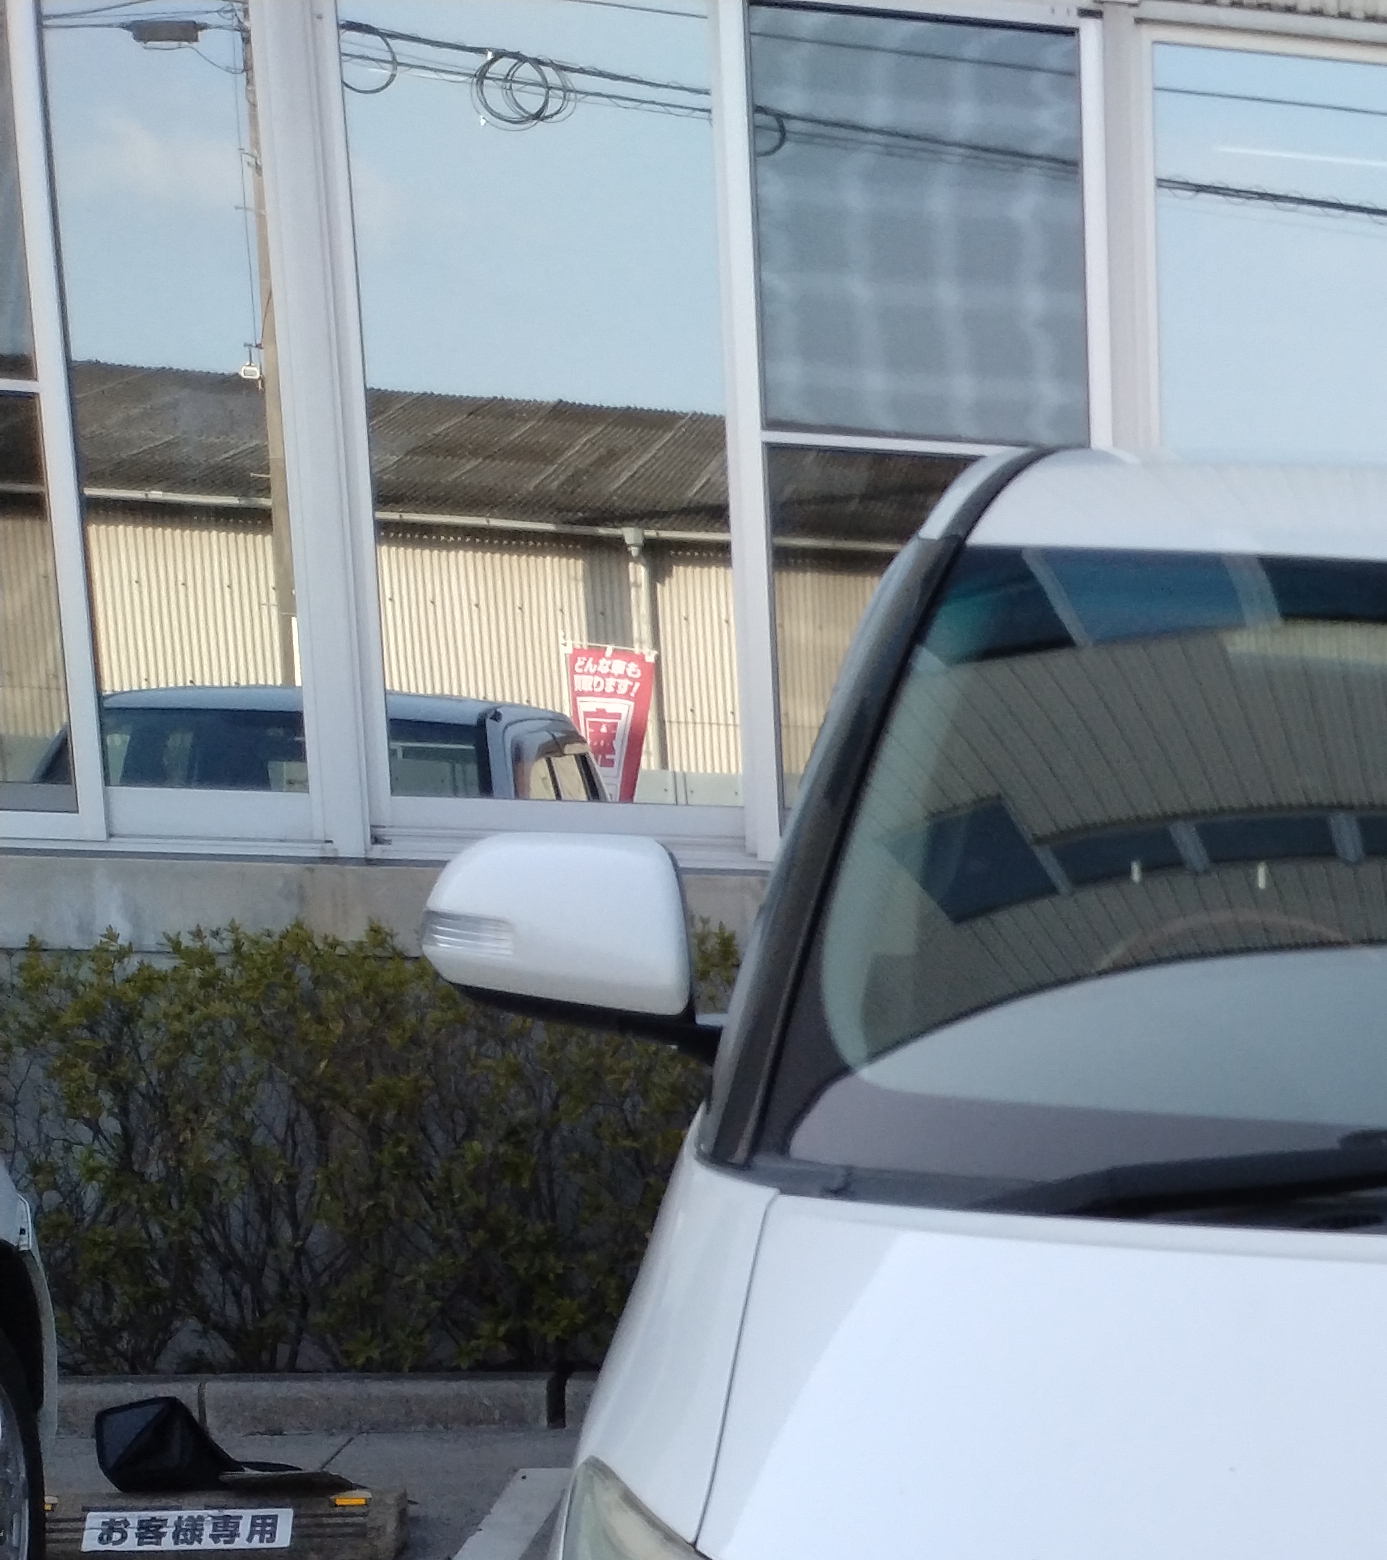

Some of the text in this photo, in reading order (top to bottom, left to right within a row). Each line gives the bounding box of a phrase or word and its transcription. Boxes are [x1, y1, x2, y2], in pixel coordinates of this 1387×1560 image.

[574, 656, 642, 679] どんな車も
[97, 1513, 280, 1547] お客様専用
